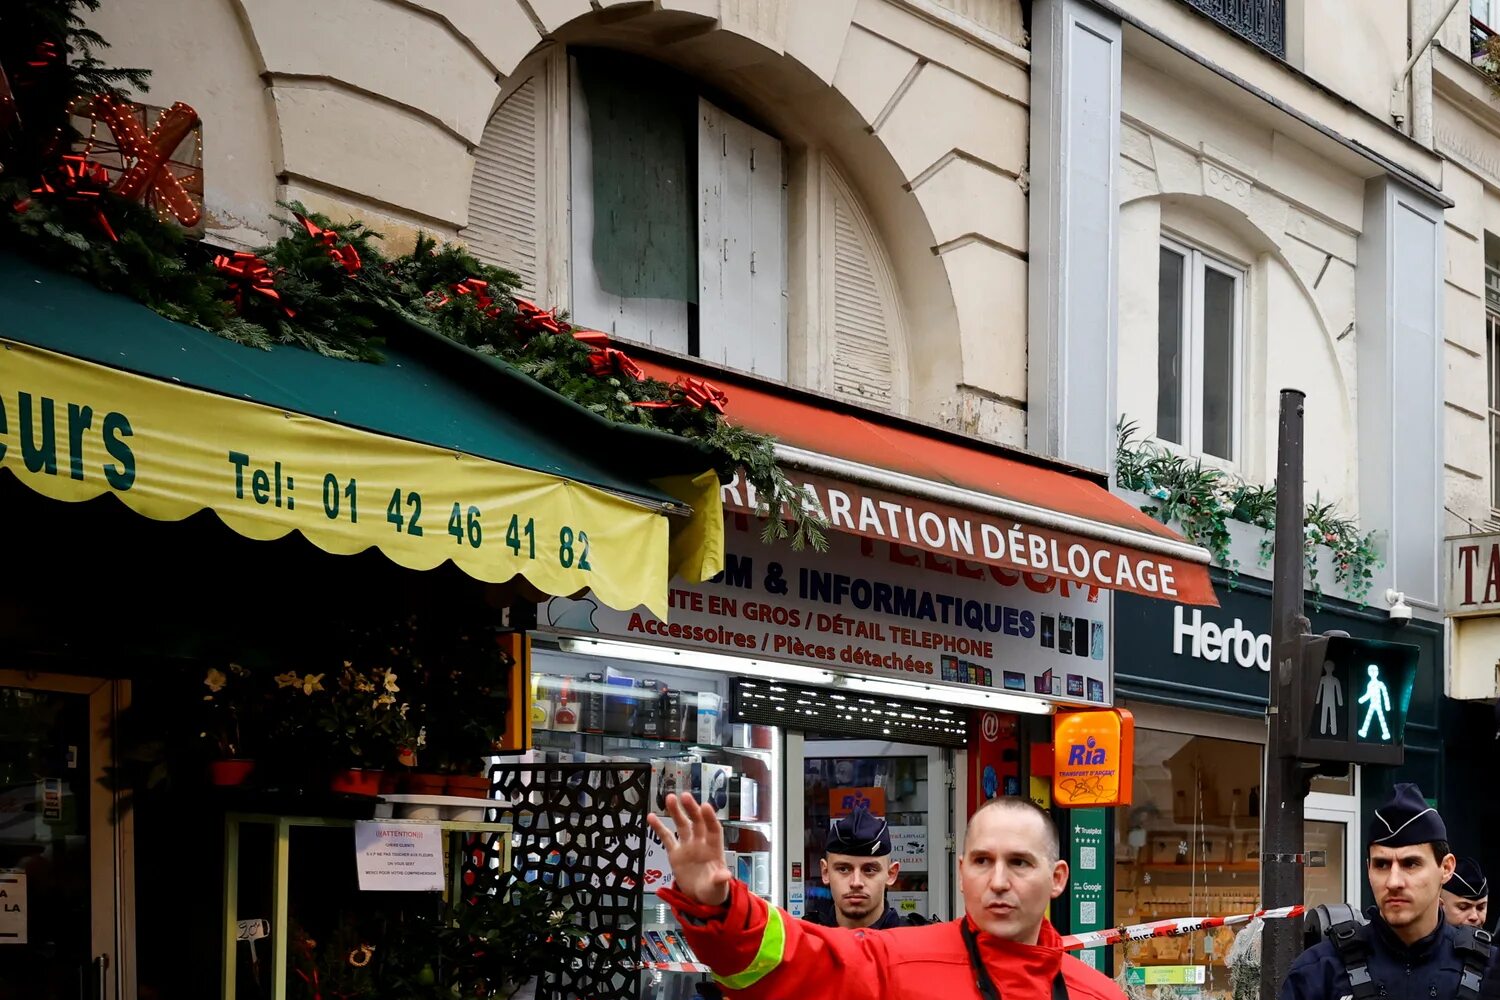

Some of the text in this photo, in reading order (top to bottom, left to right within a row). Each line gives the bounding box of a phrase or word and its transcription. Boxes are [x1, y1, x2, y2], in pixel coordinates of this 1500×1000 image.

[0, 391, 136, 492] urs
[228, 450, 592, 572] Tel: 01 42 46 41 82
[981, 523, 1178, 597] DÉBLOCAGE
[708, 595, 738, 618] EN
[742, 601, 801, 628] GROS
[804, 611, 813, 630] /
[817, 608, 886, 642] DÉTAIL
[888, 625, 994, 659] TELEPHONE
[763, 561, 789, 596] &
[798, 566, 1036, 639] INFORMATIQUES
[627, 612, 934, 675] Accessoires / Pièces détachées
[1173, 605, 1272, 672] Herbo
[1068, 735, 1106, 766] Ria
